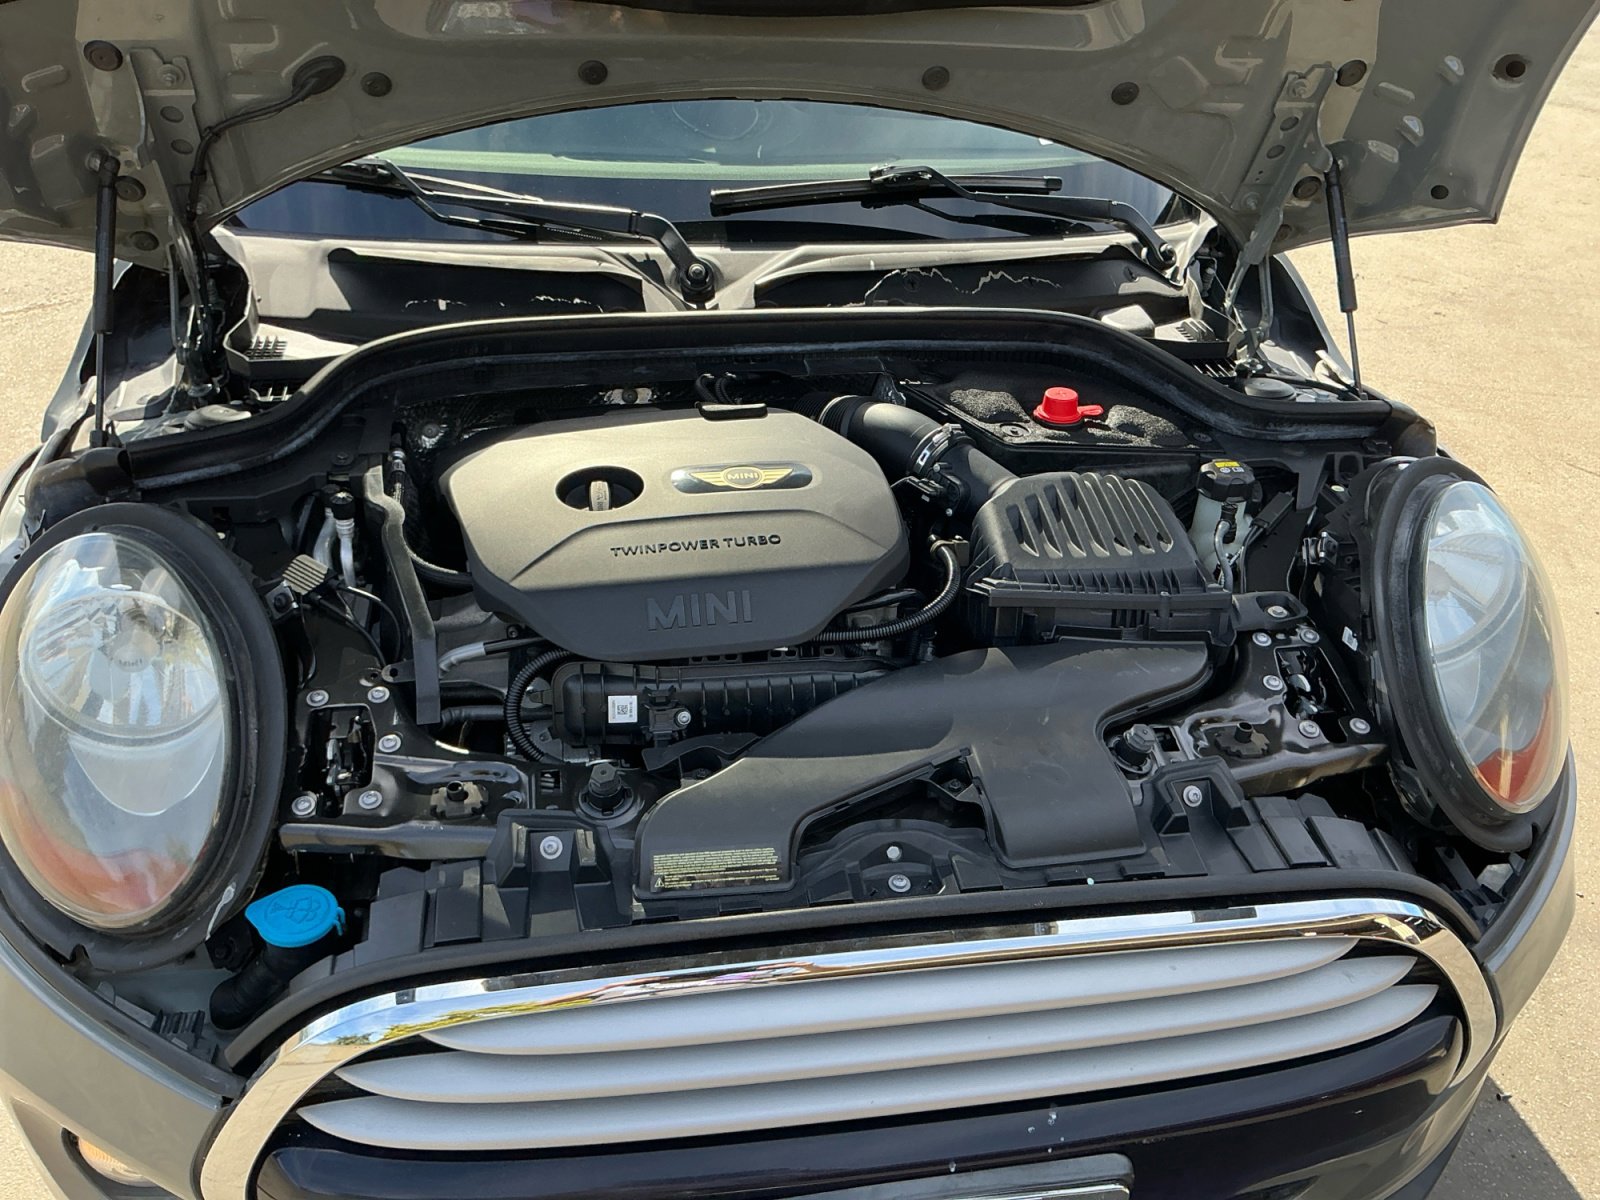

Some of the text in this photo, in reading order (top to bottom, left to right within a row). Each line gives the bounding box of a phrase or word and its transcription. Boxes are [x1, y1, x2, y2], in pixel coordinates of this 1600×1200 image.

[727, 472, 759, 480] MINI
[610, 534, 782, 557] TWINPOWER TURBO
[647, 590, 752, 631] MINI
